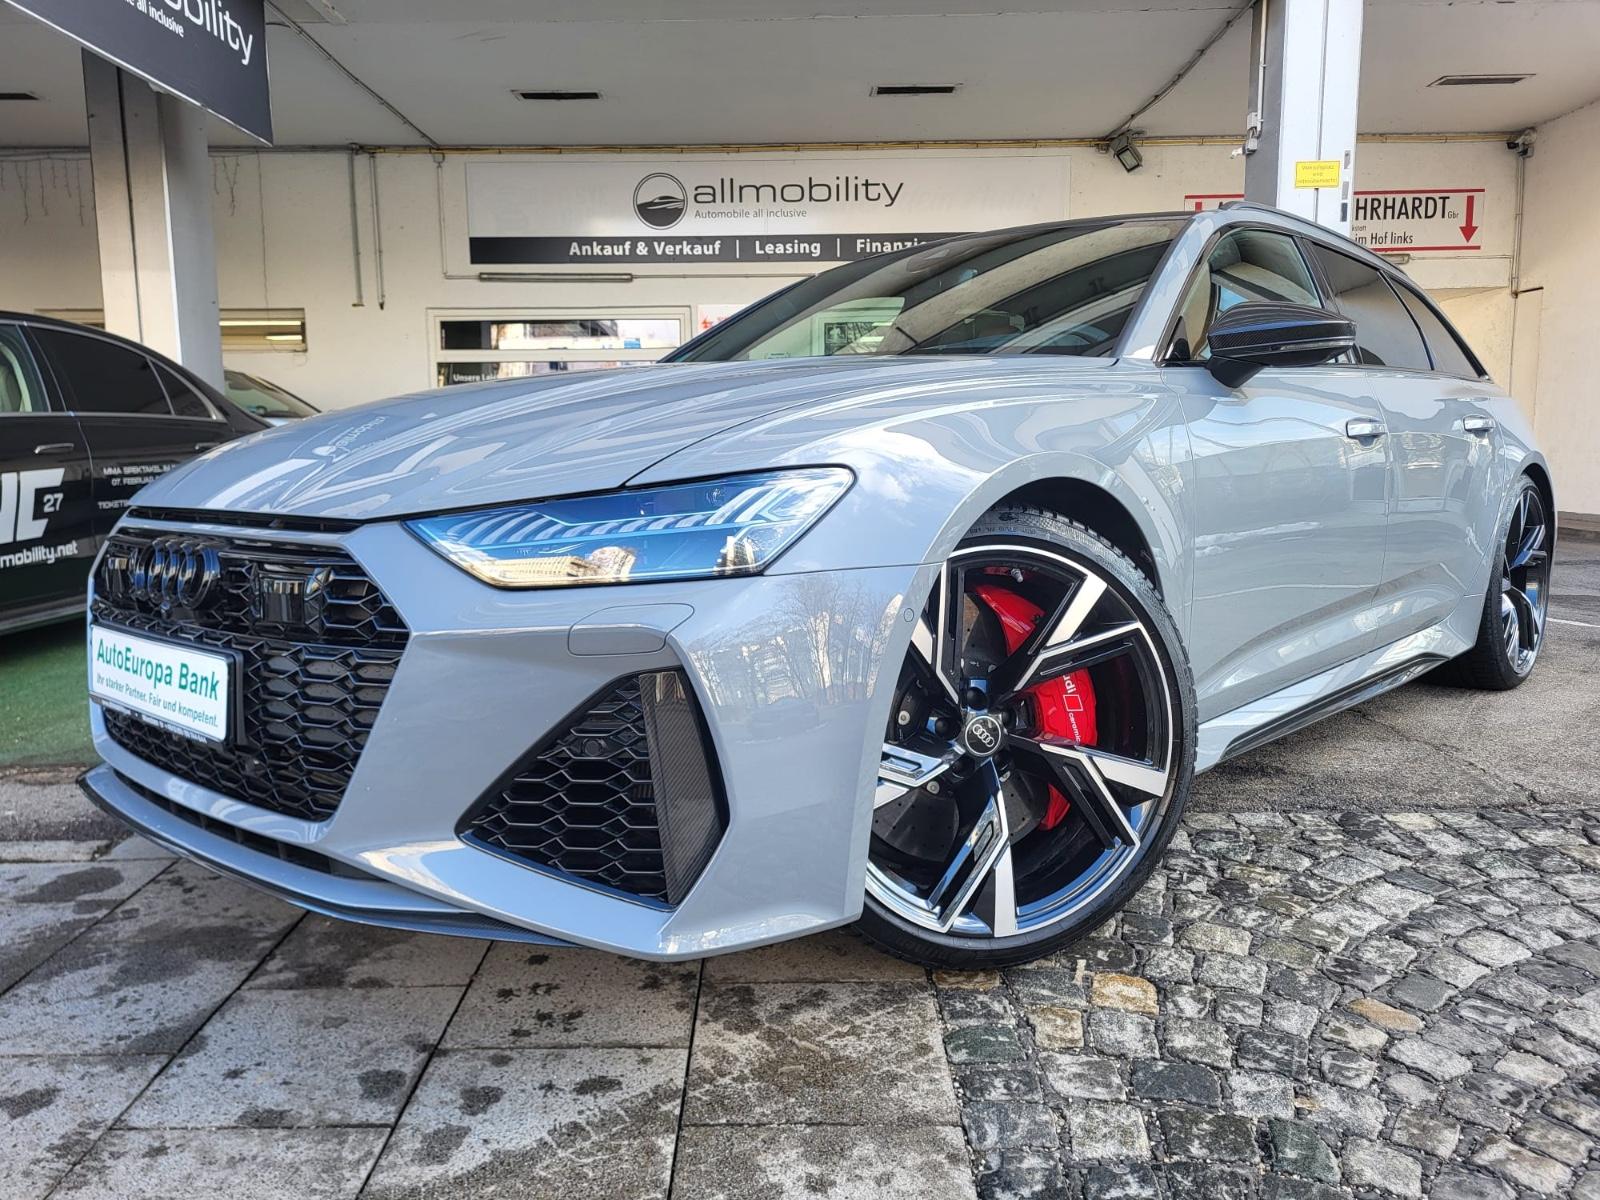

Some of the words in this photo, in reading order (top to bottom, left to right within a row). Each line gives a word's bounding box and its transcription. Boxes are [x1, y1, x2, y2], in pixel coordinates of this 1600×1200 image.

[148, 2, 185, 38] inclusive
[163, 0, 253, 66] bility
[693, 176, 904, 208] allmobility
[694, 208, 750, 219] Automobile
[752, 208, 764, 219] all
[766, 208, 808, 219] inclusive
[1447, 210, 1460, 219] Gbr
[569, 241, 631, 256] Ankauf
[636, 241, 649, 256] &
[653, 240, 722, 256] Verkauf
[755, 239, 821, 257] Leasing
[856, 238, 927, 253] Finanzi
[1370, 231, 1389, 245] Hof
[1390, 231, 1414, 245] links
[43, 493, 64, 513] 27
[97, 638, 173, 689] AutoEuropa
[178, 662, 220, 701] Bank
[97, 673, 105, 685] Ihr
[105, 676, 125, 693] starker
[125, 684, 147, 702] Partner.
[148, 692, 162, 706] Fair
[162, 700, 177, 713] und
[178, 702, 219, 728] kompetent.
[1068, 712, 1081, 743] ceramic
